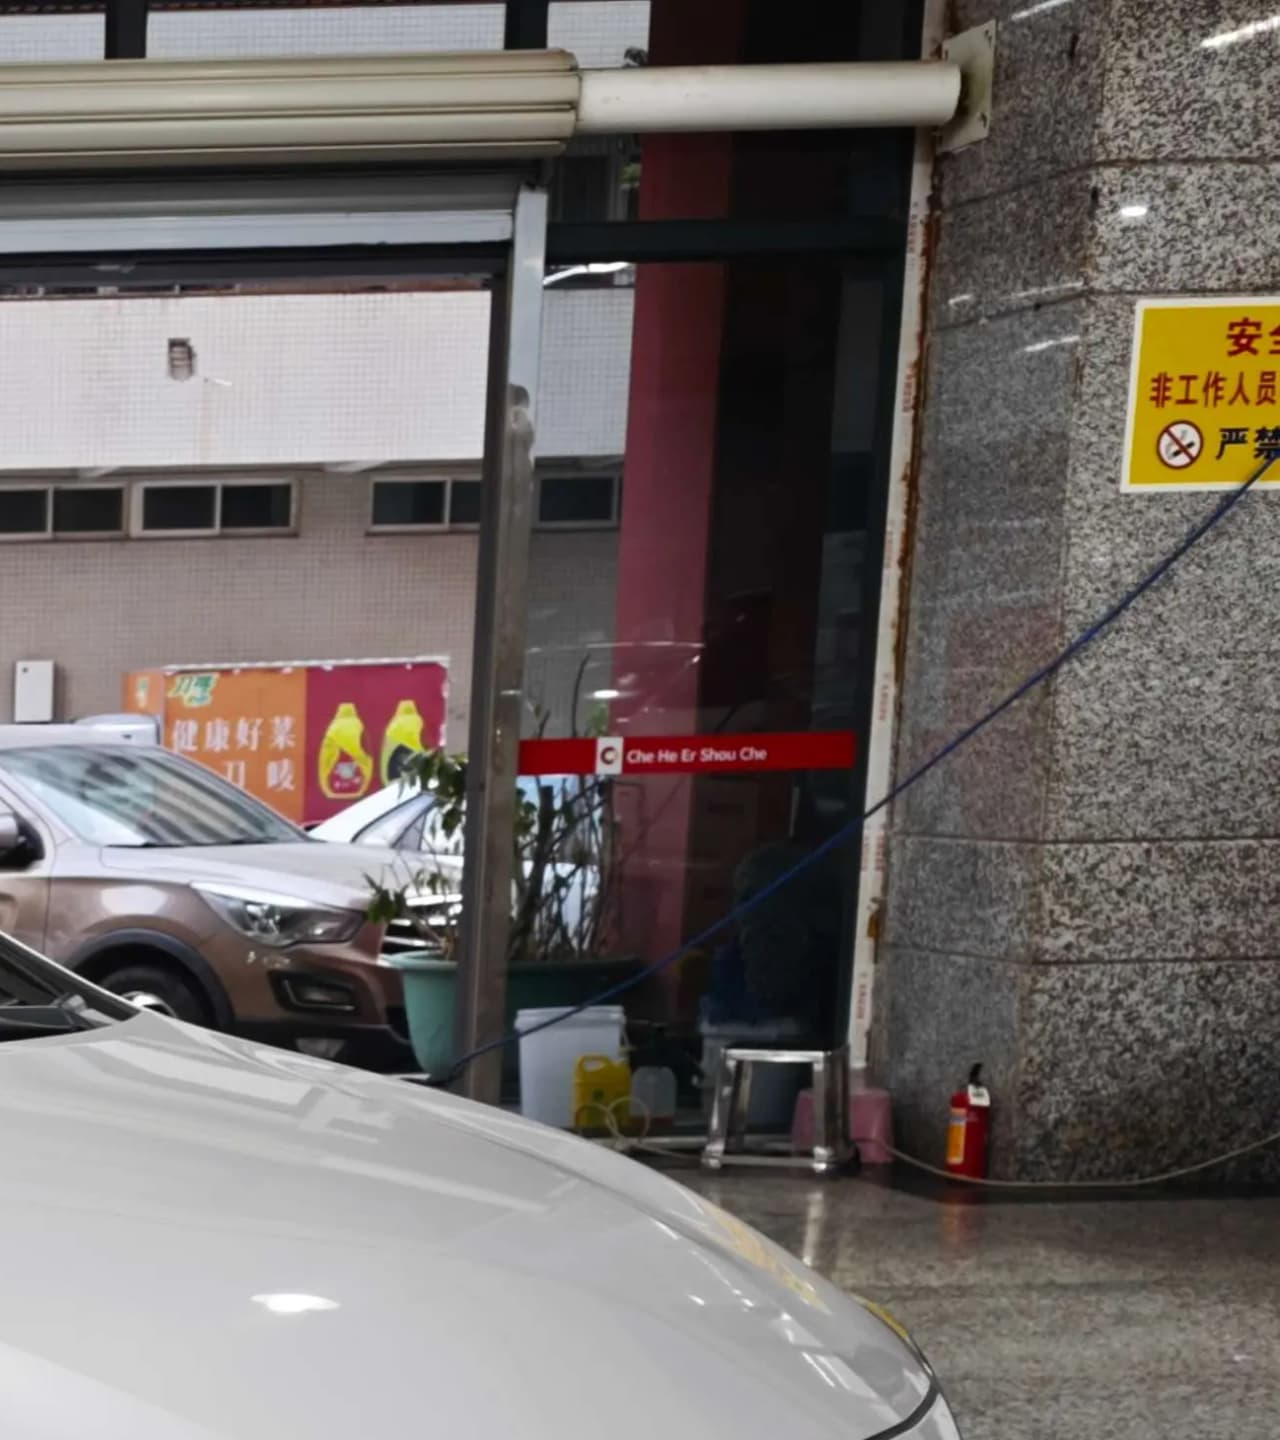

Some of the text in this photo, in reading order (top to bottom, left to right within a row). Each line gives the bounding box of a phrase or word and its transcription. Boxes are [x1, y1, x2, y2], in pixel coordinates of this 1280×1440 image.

[1149, 371, 1277, 408] 非工作人员
[172, 716, 296, 753] 健康好菜
[626, 748, 654, 764] Che
[657, 749, 678, 763] He
[681, 748, 697, 762] Er
[739, 746, 768, 761] Che
